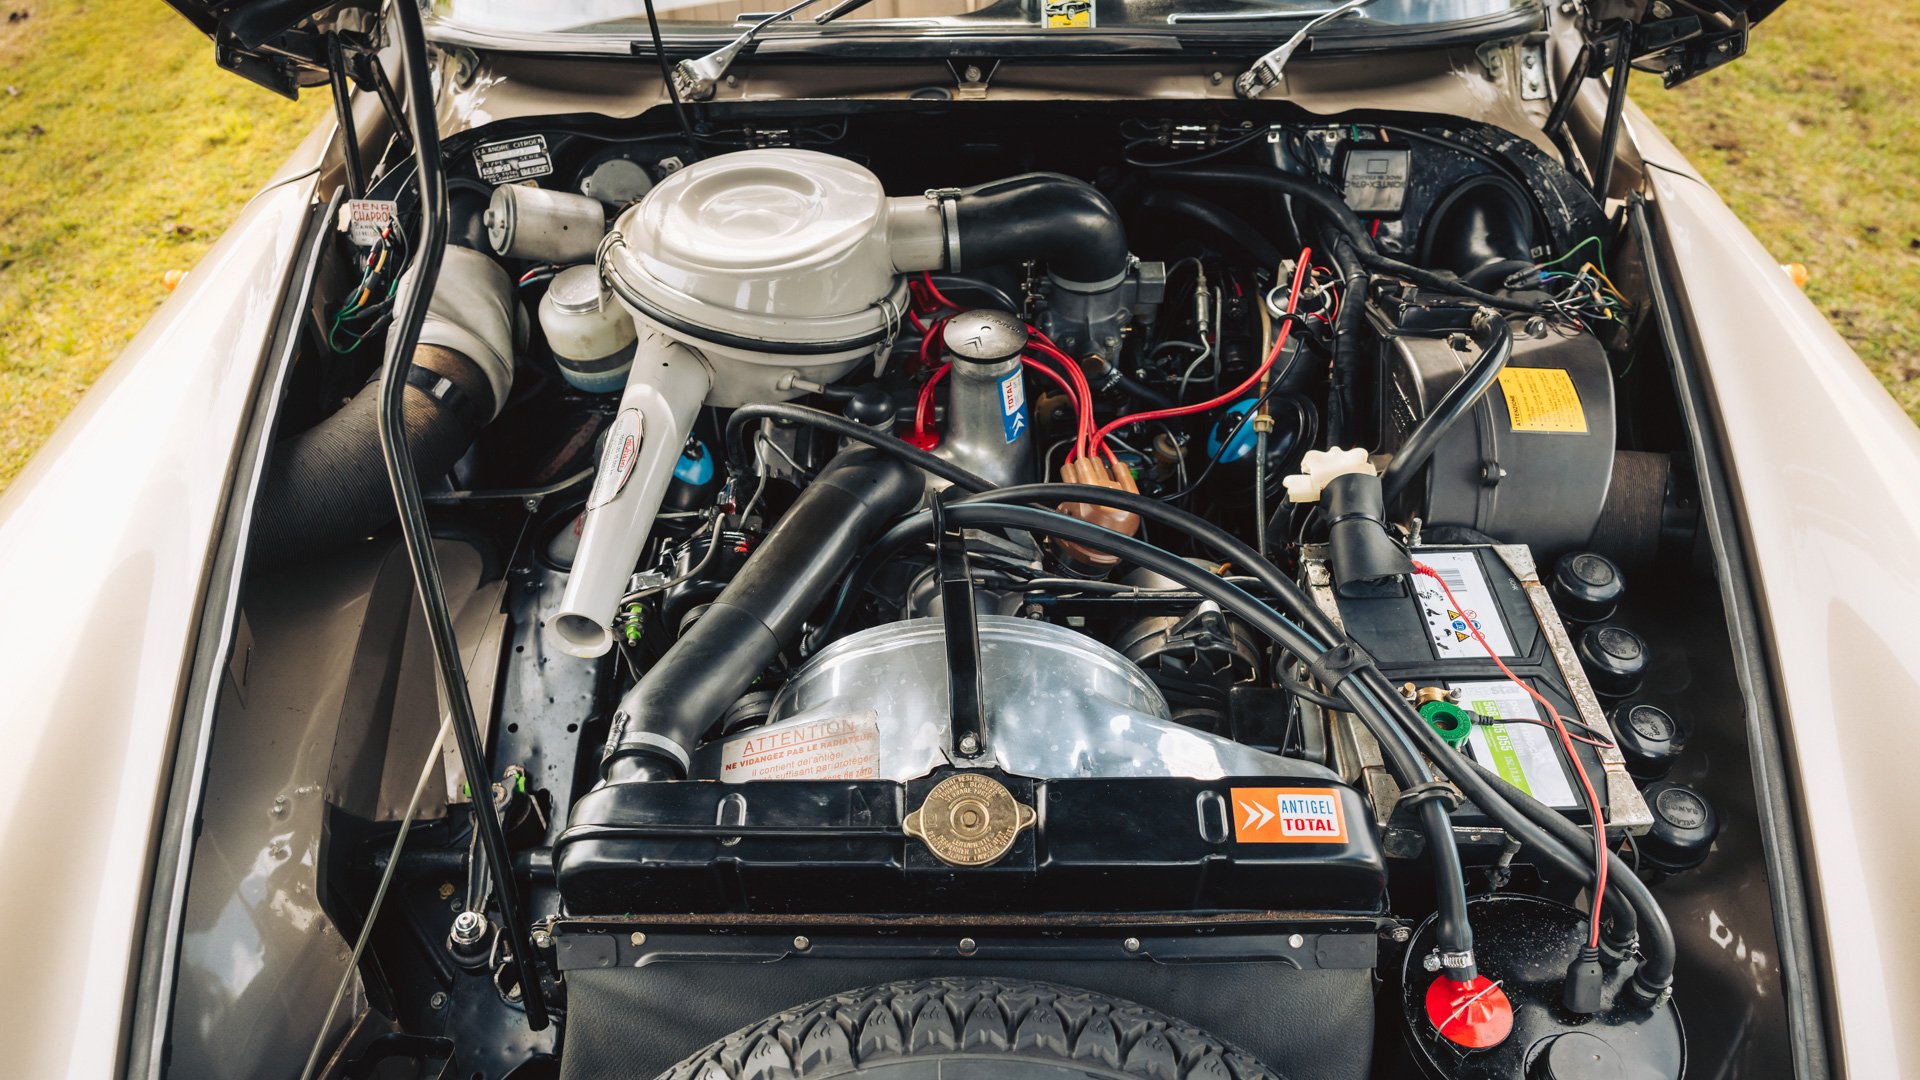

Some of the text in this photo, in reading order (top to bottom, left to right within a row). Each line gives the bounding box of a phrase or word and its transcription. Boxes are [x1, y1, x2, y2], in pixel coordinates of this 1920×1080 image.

[352, 202, 394, 211] HENRI
[1006, 382, 1014, 410] TOTAL
[1510, 395, 1521, 426] ATTENZIONE
[743, 719, 856, 755] ATTENTION
[1496, 736, 1512, 752] 055
[725, 733, 873, 770] NE VIDANGEZ PAS LE RADIATEUR
[760, 761, 795, 776] contient
[776, 766, 814, 780] suffisant
[1281, 799, 1334, 815] ANTIGEL
[1282, 818, 1336, 832] TOTAL
[927, 830, 946, 852] REMOVE
